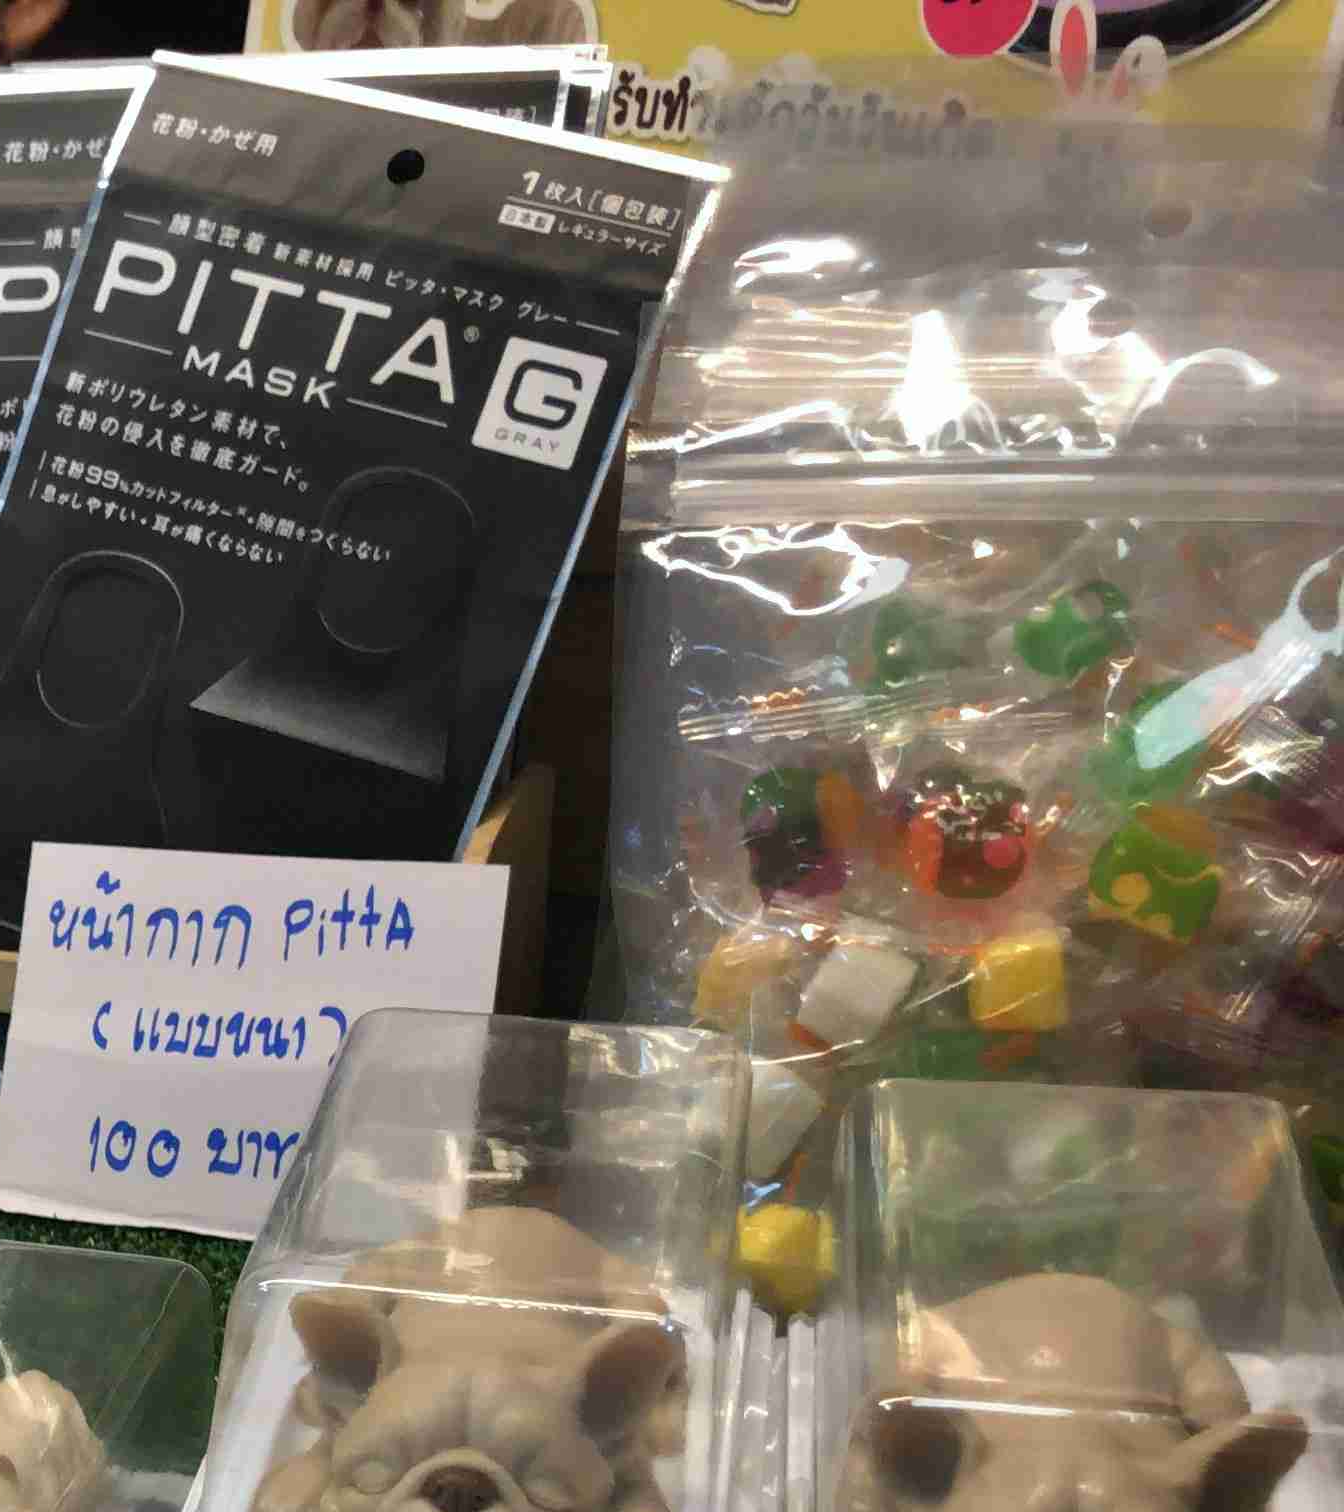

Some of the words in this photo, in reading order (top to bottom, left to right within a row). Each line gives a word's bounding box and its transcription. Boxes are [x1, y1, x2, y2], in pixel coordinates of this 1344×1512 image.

[93, 239, 456, 405] PITTA
[503, 359, 583, 431] G
[182, 344, 338, 410] MASK
[493, 427, 561, 452] GRAY
[48, 870, 252, 970] หน้ากาก
[89, 1116, 181, 1178] 100
